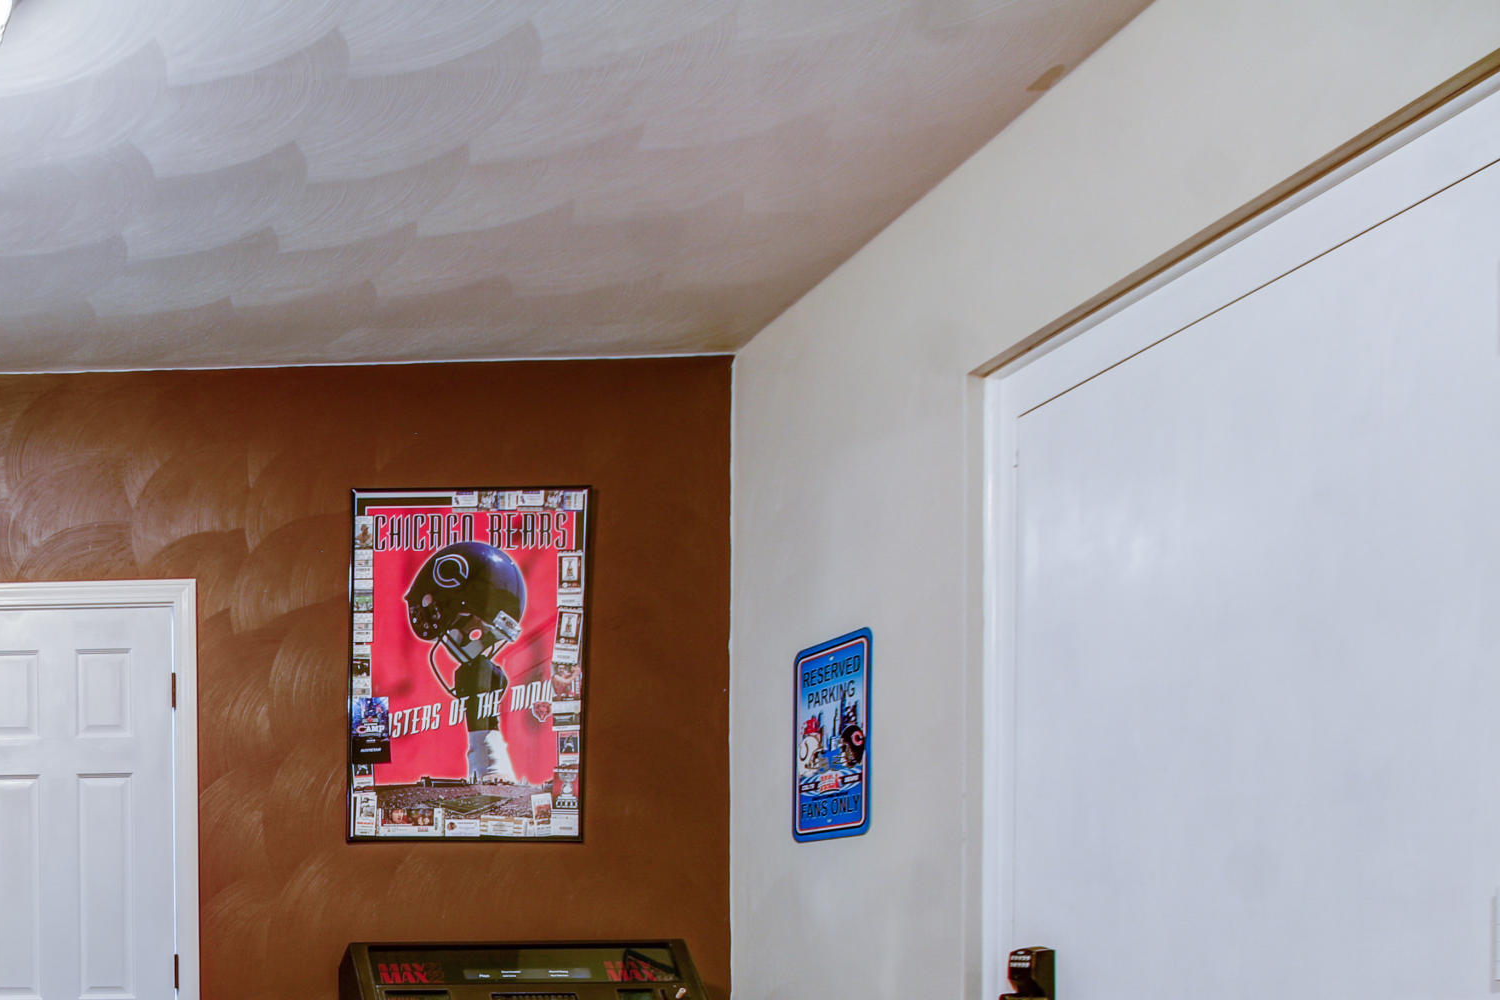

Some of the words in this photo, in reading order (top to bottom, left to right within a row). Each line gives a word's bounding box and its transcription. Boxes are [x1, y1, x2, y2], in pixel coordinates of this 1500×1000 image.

[373, 513, 475, 551] CHICAGO
[485, 512, 567, 550] BEARS
[803, 655, 860, 688] RESERVED
[448, 696, 470, 726] OF
[476, 688, 504, 720] THE
[808, 680, 855, 709] PARKING
[801, 801, 827, 819] FANS
[831, 794, 860, 815] ONLY
